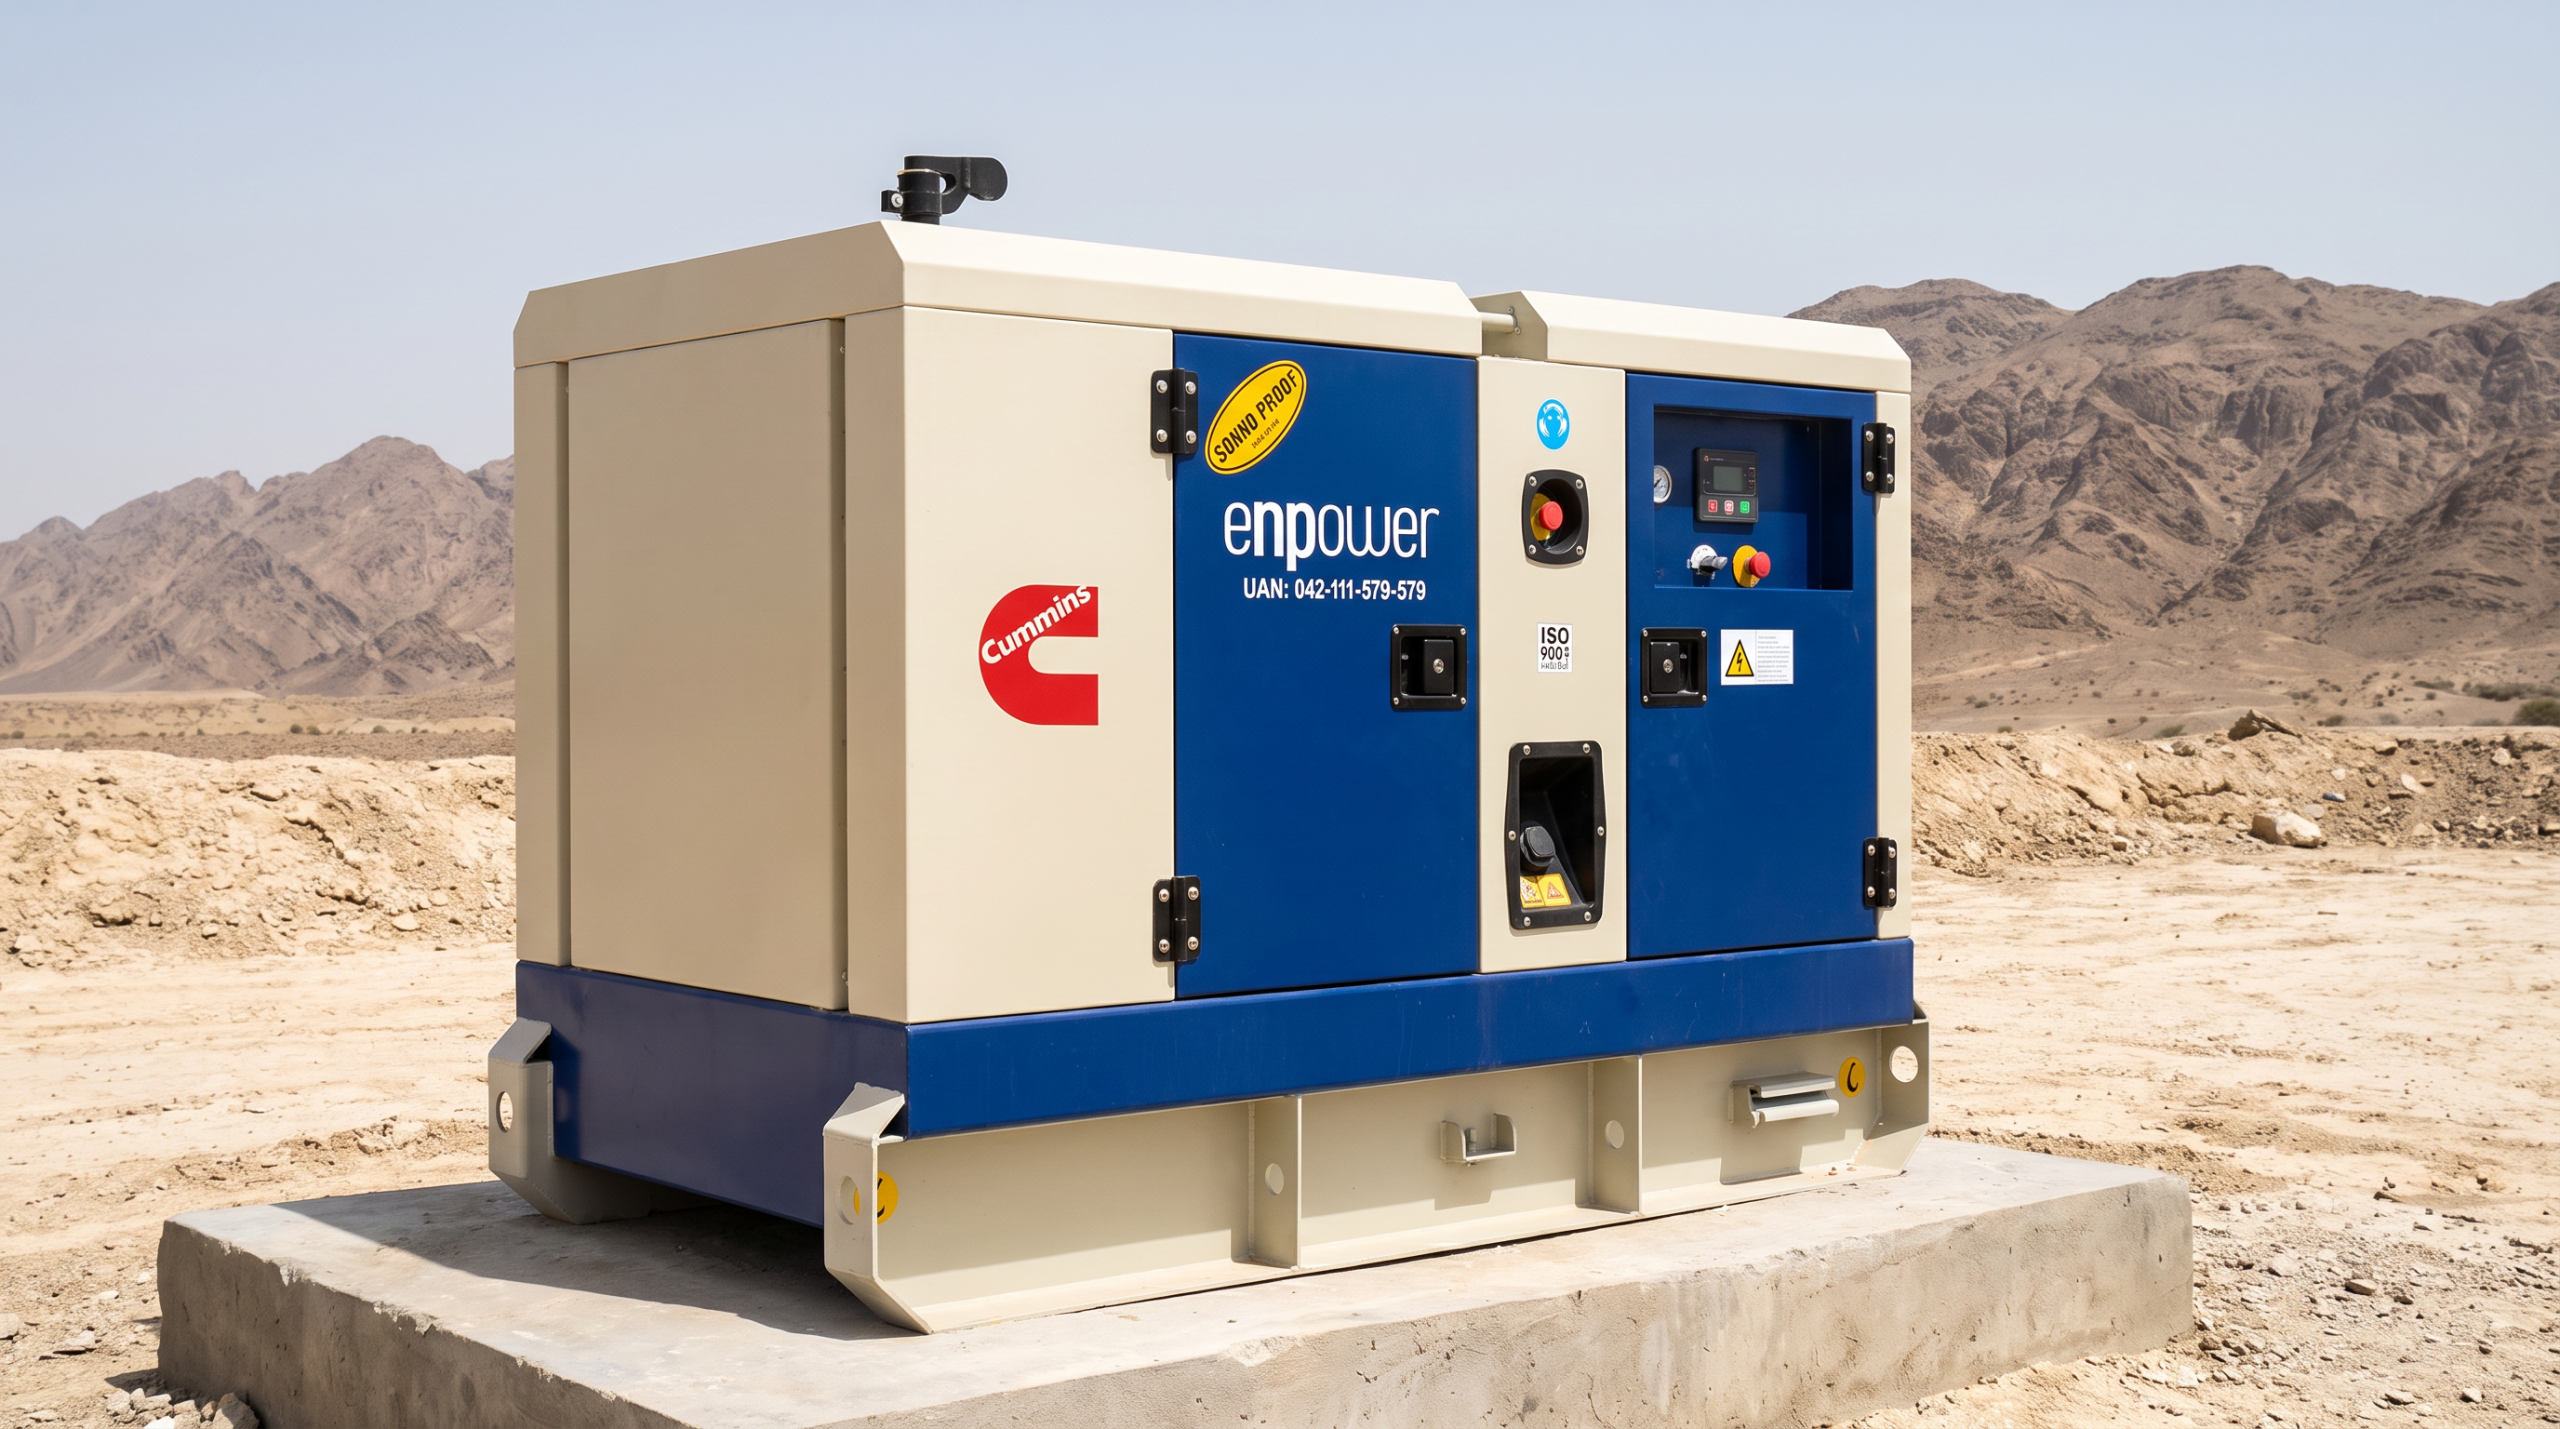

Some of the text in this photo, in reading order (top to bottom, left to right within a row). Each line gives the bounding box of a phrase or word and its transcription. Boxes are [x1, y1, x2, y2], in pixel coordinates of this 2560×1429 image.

[1214, 413, 1258, 463] SONNO
[1255, 369, 1297, 420] PROOF
[1224, 501, 1440, 571] enpower
[1243, 577, 1426, 600] UAN: 042-111-579-579
[981, 585, 1091, 664] Cummins
[1541, 626, 1569, 645] ISO
